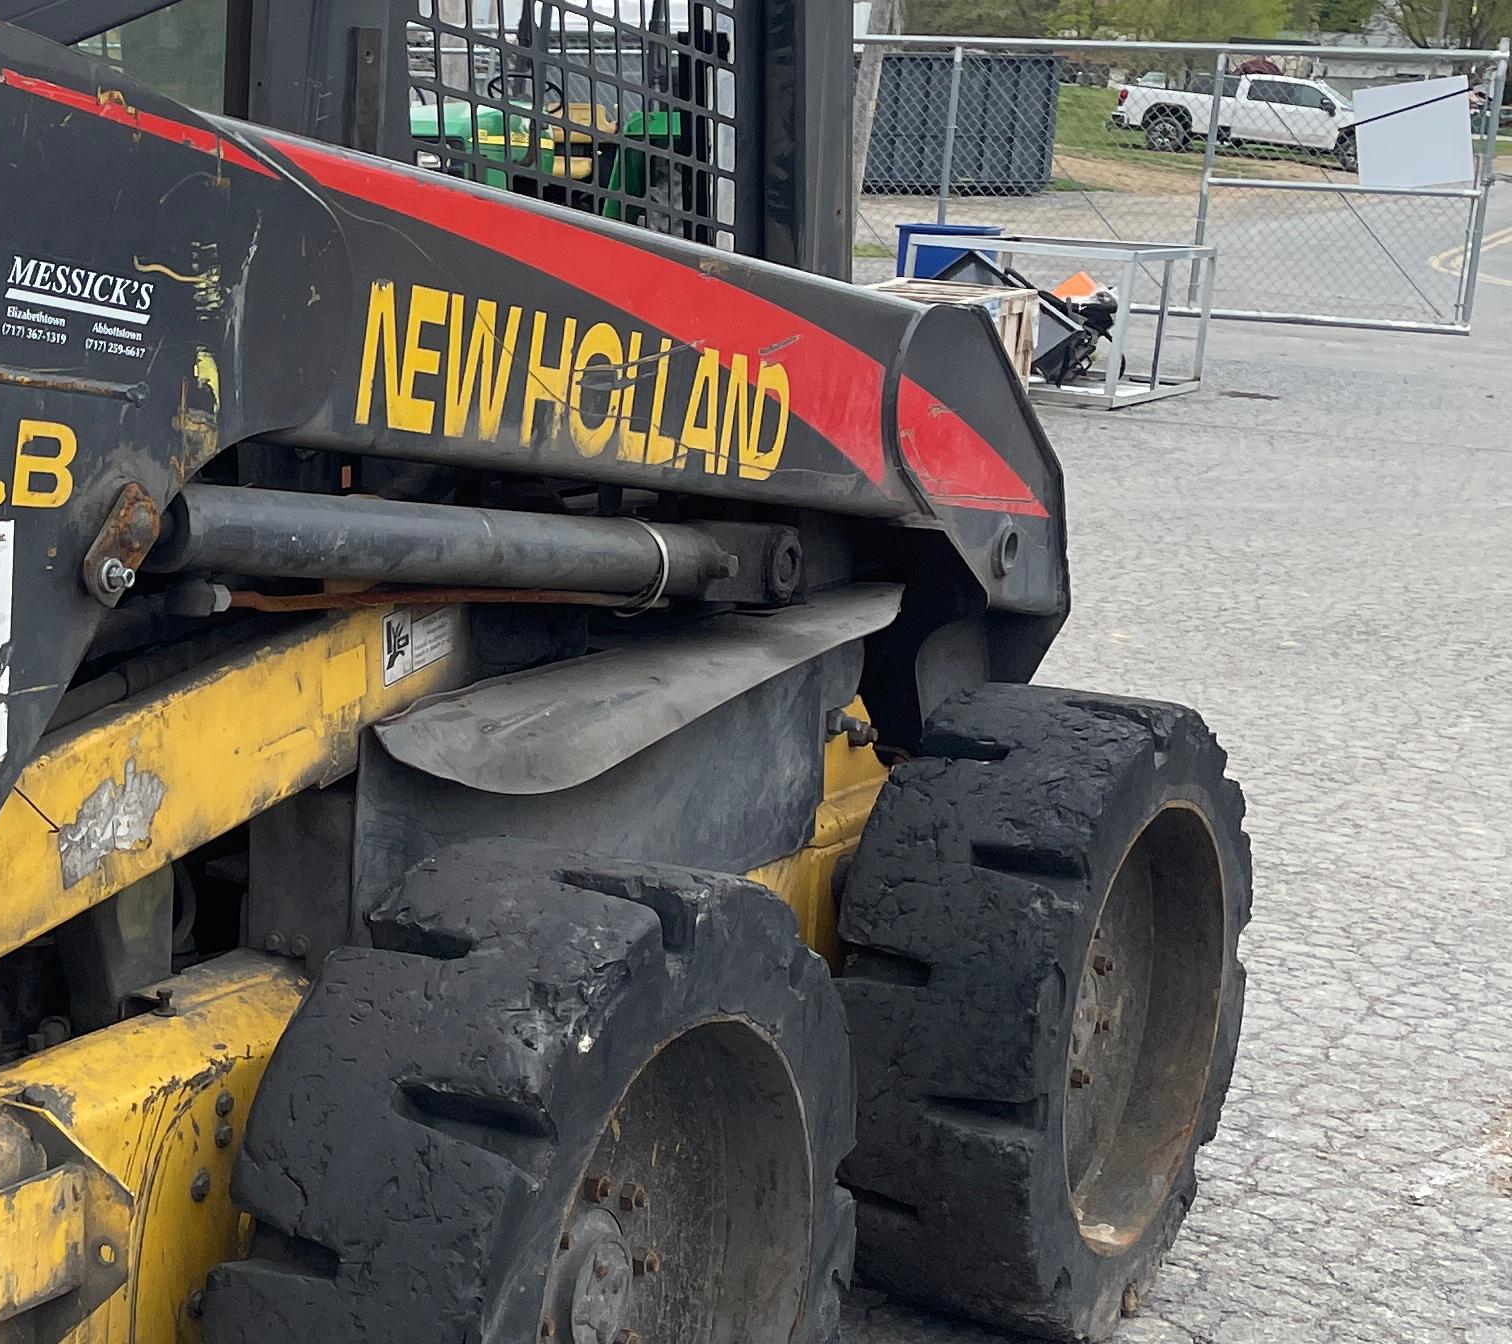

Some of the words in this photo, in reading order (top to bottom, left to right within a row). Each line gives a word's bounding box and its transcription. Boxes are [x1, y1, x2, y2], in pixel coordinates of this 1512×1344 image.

[7, 255, 154, 310] MESSICK'S
[6, 305, 66, 328] Elizabethtown
[1, 322, 25, 338] (717)
[26, 326, 67, 345] 367-1319
[91, 322, 143, 342] Abbottstown
[85, 337, 107, 353] (717)
[107, 341, 146, 359] 259-6617
